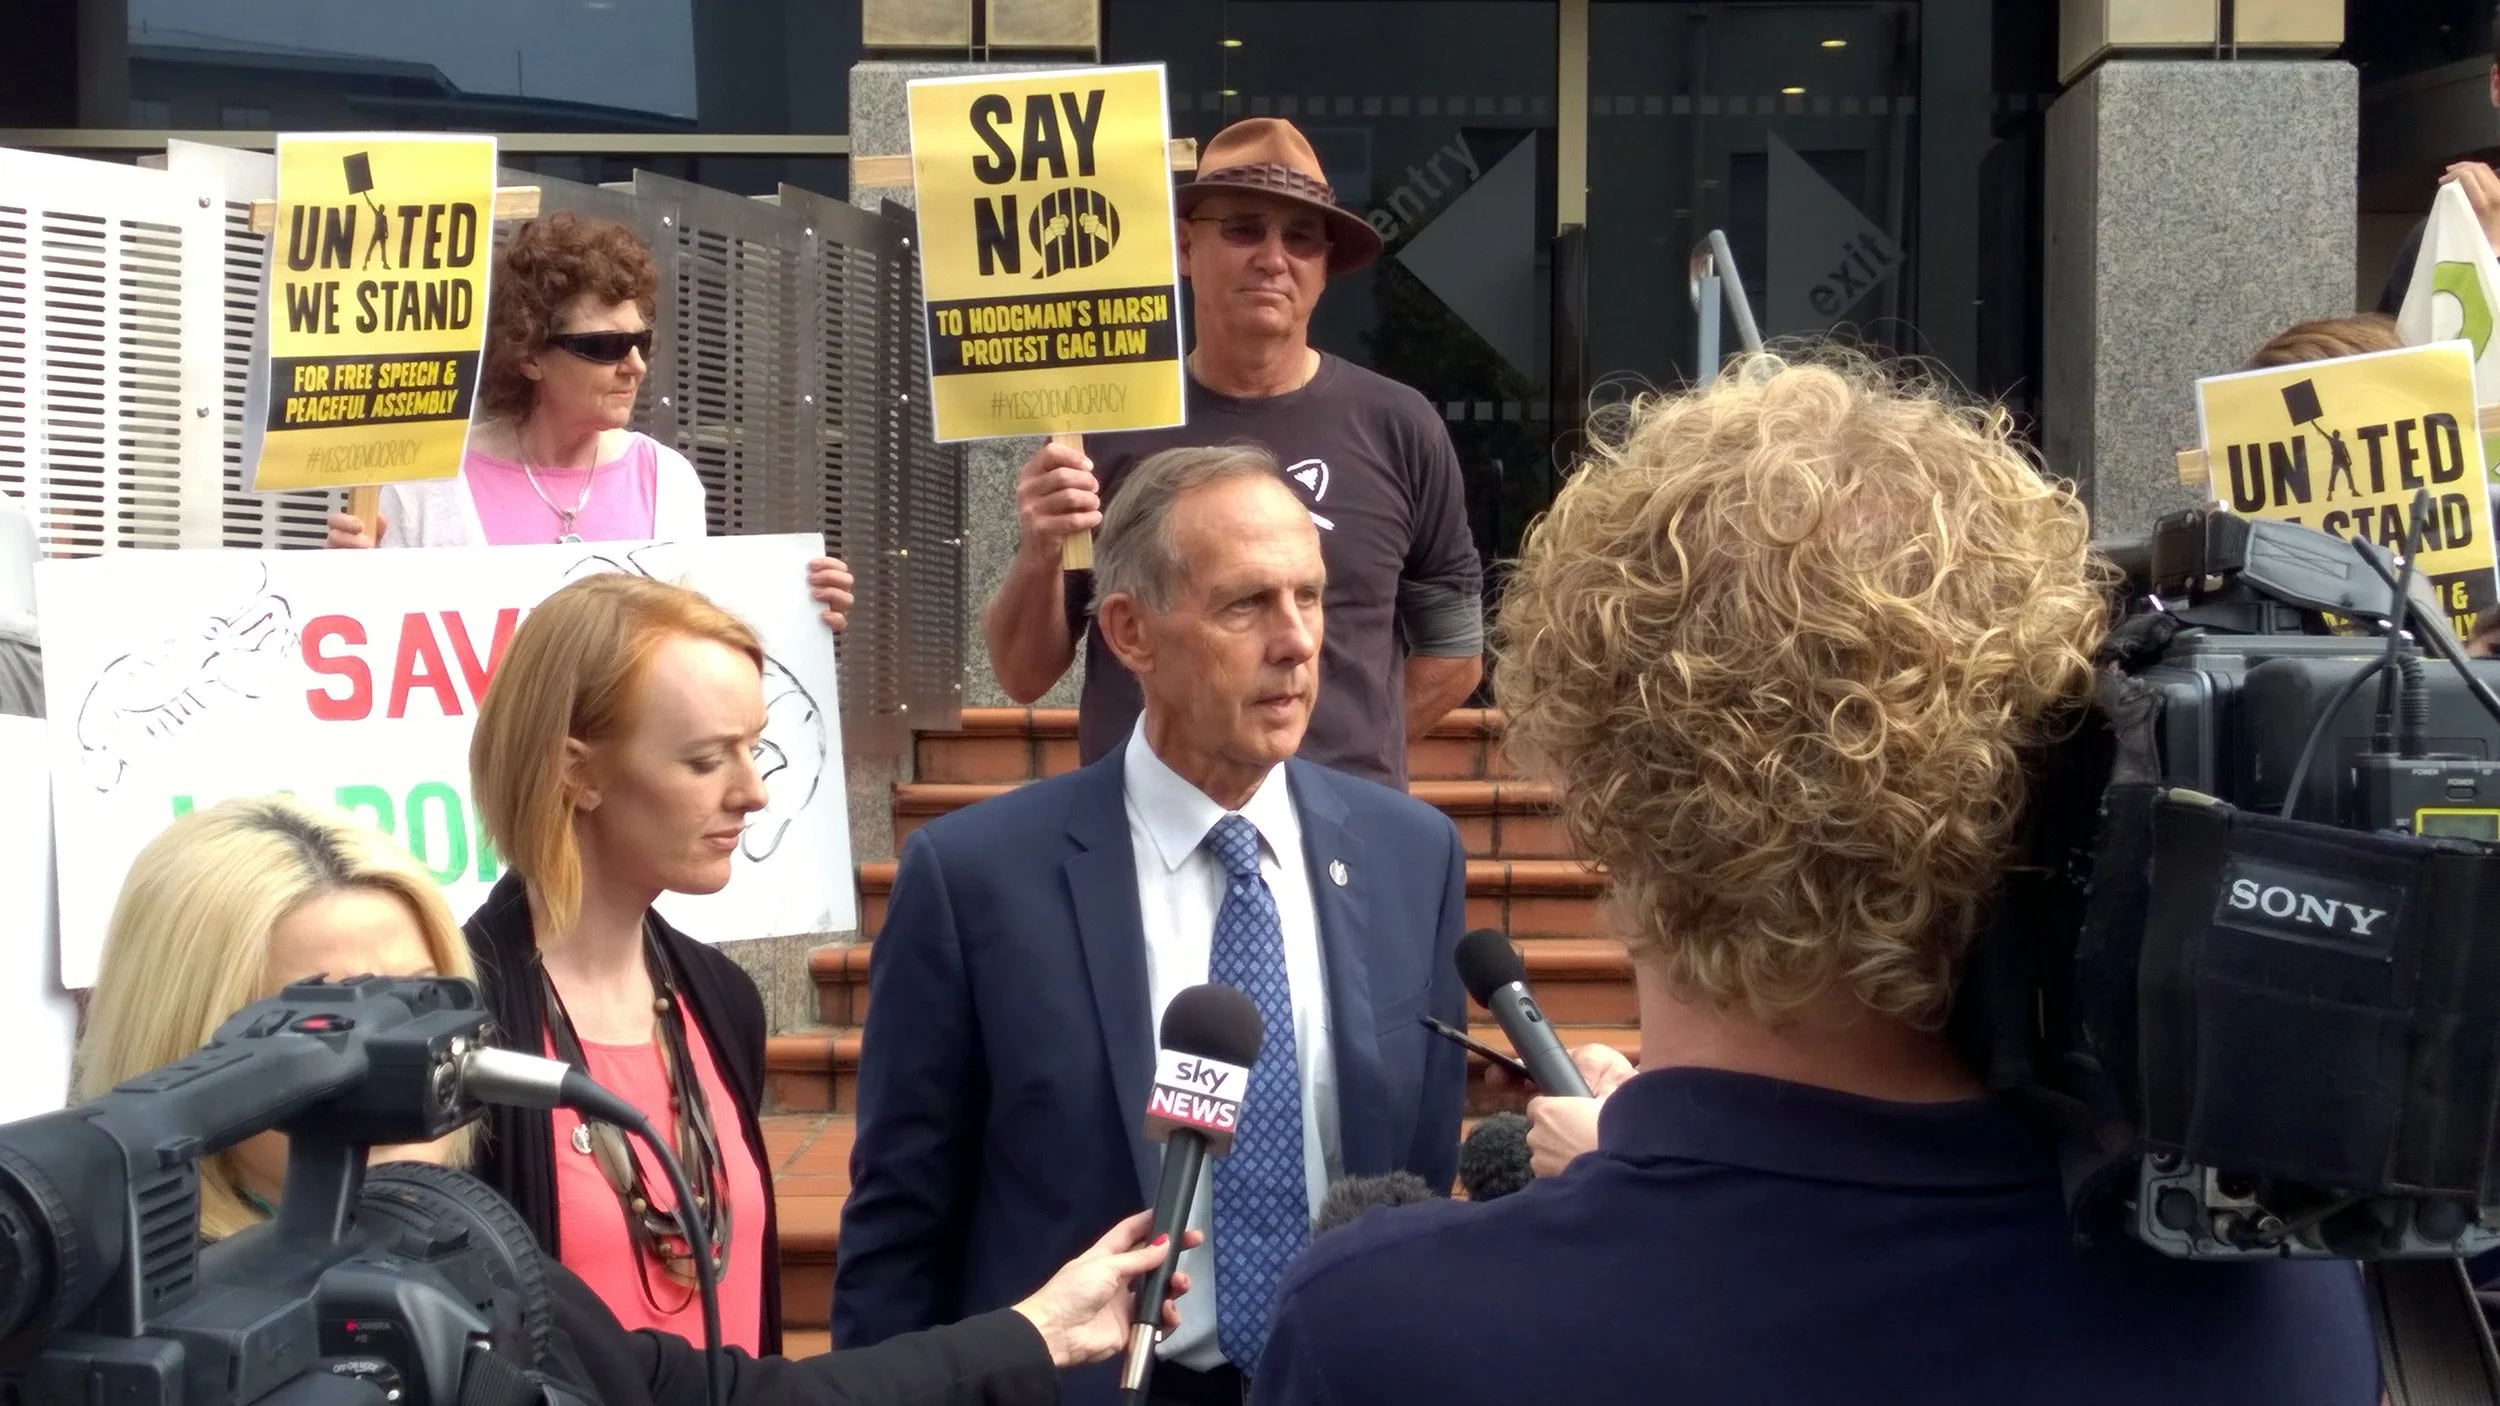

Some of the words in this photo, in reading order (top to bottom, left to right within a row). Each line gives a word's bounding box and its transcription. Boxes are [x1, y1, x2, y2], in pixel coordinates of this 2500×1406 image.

[969, 89, 1105, 184] SAY
[1366, 130, 1481, 242] entry
[1809, 230, 1895, 318] exit
[286, 280, 340, 334] WE
[355, 279, 473, 333] STAND
[936, 309, 963, 336] TO
[970, 300, 1091, 335] HODGMAN'S
[1098, 295, 1168, 326] HARSH
[961, 335, 1048, 366] PROTEST
[1056, 331, 1096, 360] GAG
[1102, 329, 1147, 357] LAW
[294, 365, 329, 392] FOR
[334, 363, 374, 390] FREE
[378, 361, 440, 389] SPEECH
[443, 360, 457, 386] &
[285, 395, 366, 423] PEACEFUL
[370, 389, 458, 418] ASSEMBLY
[990, 384, 1127, 423] #YES2DEMOCRACY
[300, 607, 536, 721] SAV
[2227, 877, 2387, 937] SONY
[1175, 1059, 1229, 1094] sky
[1151, 1087, 1236, 1128] NEWS
